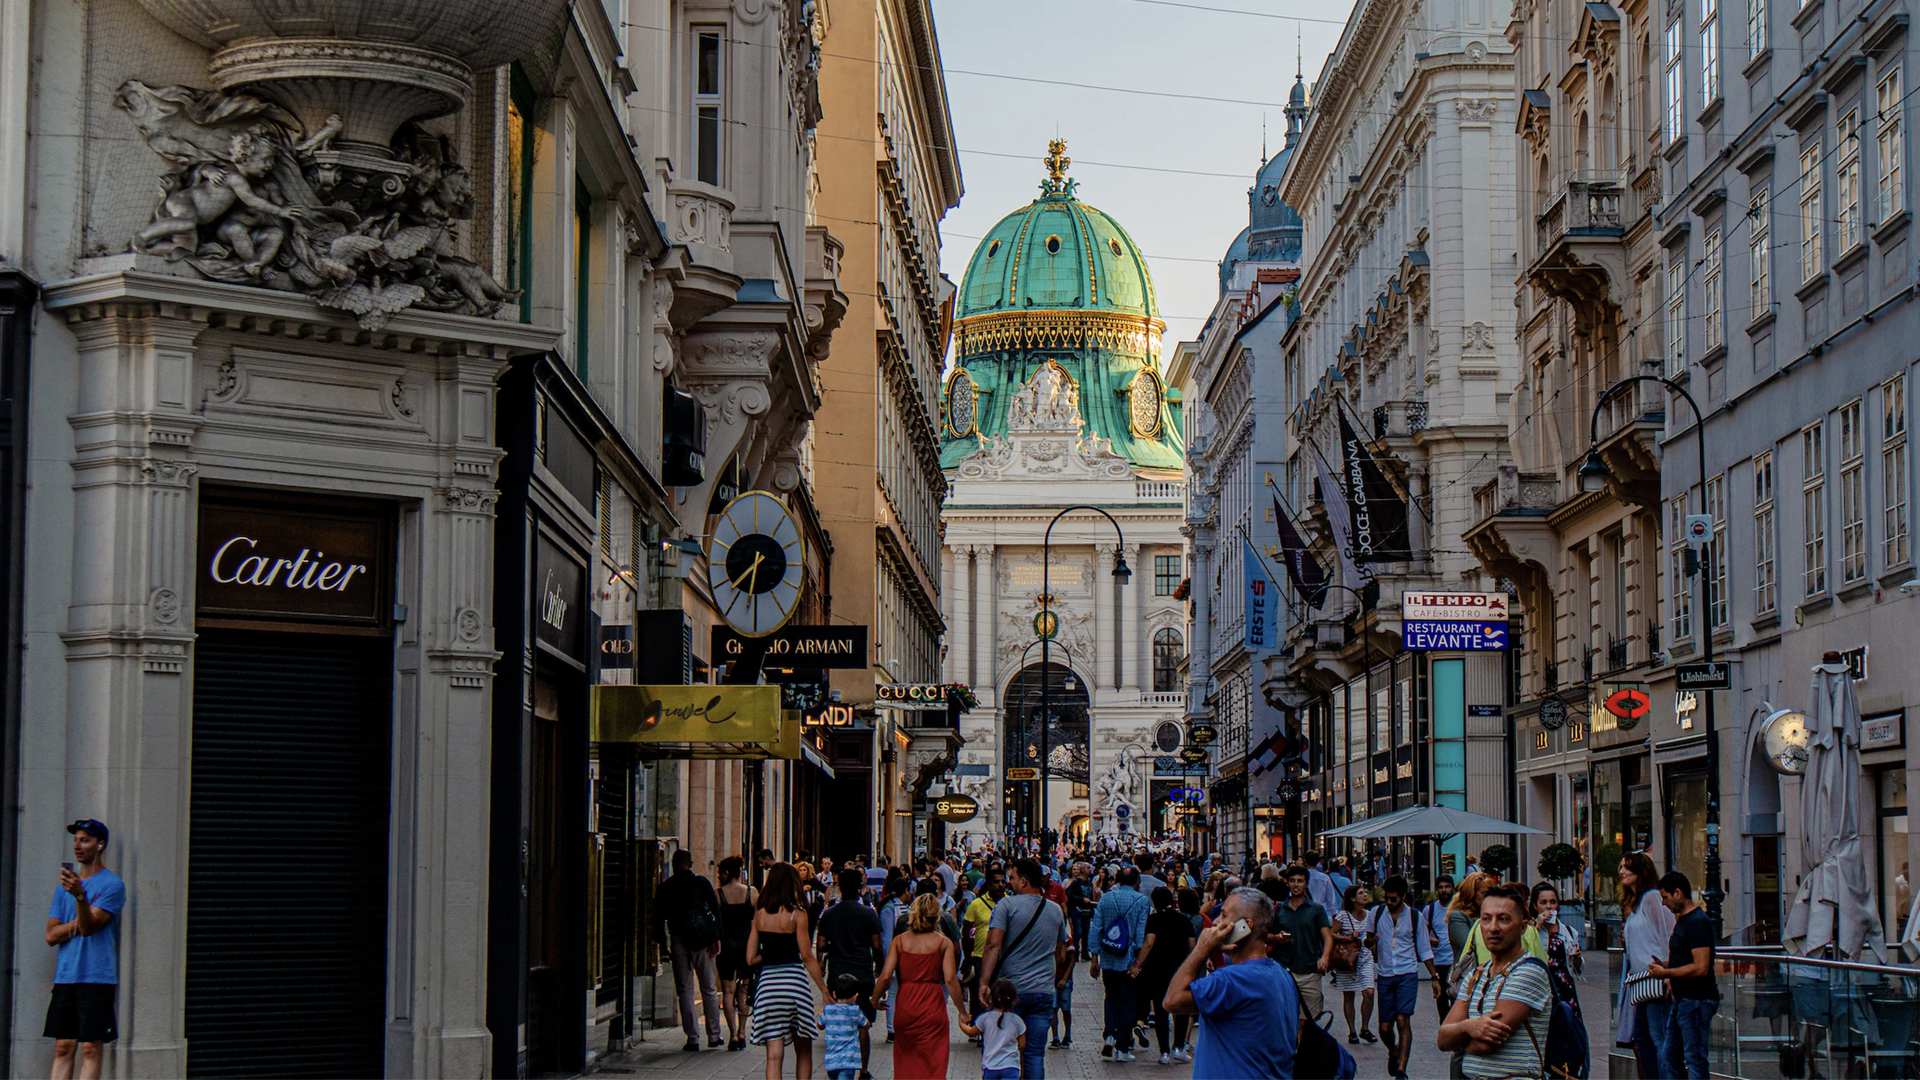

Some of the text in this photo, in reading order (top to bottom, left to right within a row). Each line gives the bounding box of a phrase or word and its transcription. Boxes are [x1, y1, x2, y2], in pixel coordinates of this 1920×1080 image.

[1347, 439, 1366, 505] GABBANA
[1357, 514, 1373, 556] DOLCE
[210, 536, 367, 591] Cartier
[542, 568, 567, 631] Cartier
[1407, 596, 1485, 605] IL TEMPO
[1250, 598, 1264, 645] ERSTE
[1407, 623, 1481, 633] RESTAURANT
[795, 639, 853, 654] ARMANI
[1407, 634, 1482, 648] LEVANTE
[878, 686, 946, 698] GUCCI
[806, 704, 854, 725] NDI
[937, 801, 950, 811] GS
